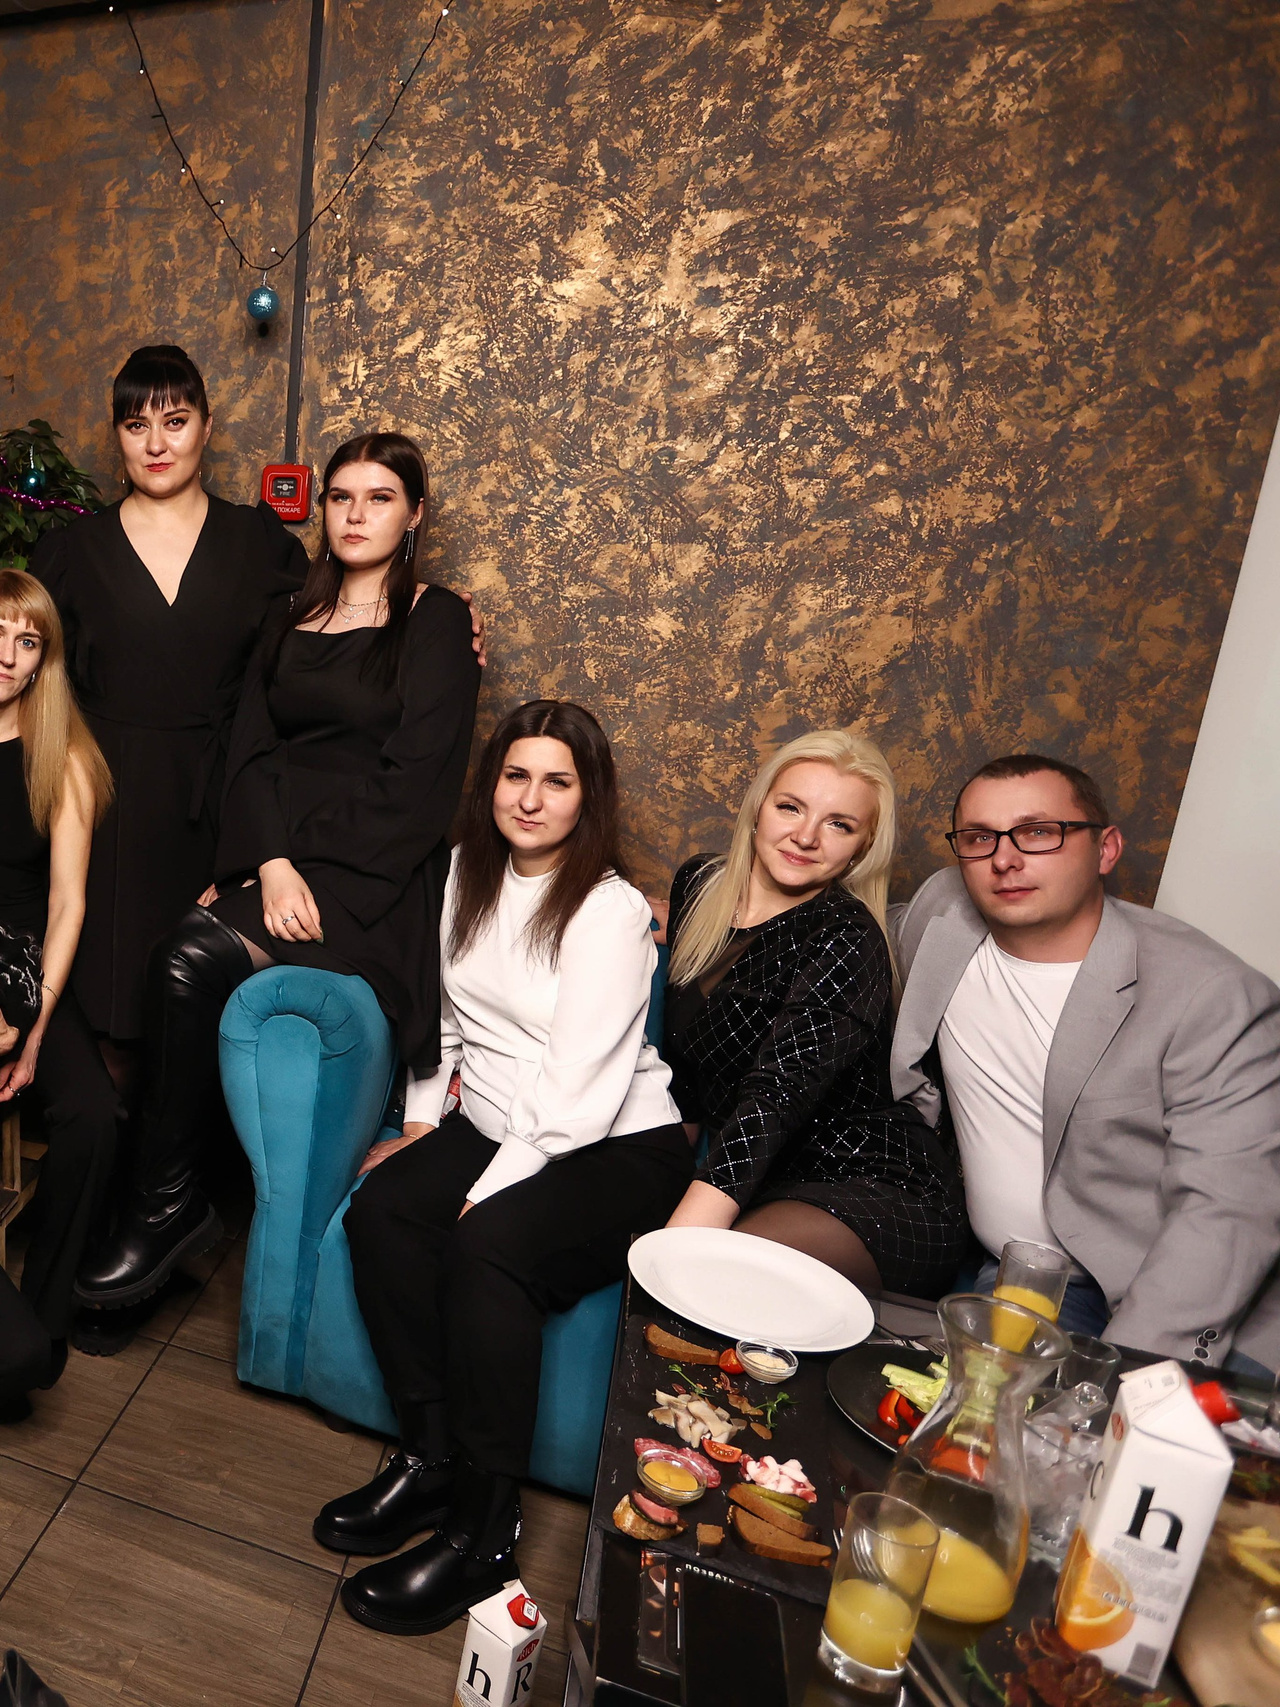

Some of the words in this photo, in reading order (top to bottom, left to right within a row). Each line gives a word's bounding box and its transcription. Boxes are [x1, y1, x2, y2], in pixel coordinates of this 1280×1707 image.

[1125, 1484, 1183, 1553] h
[464, 1649, 491, 1703] h
[510, 1662, 532, 1704] R
